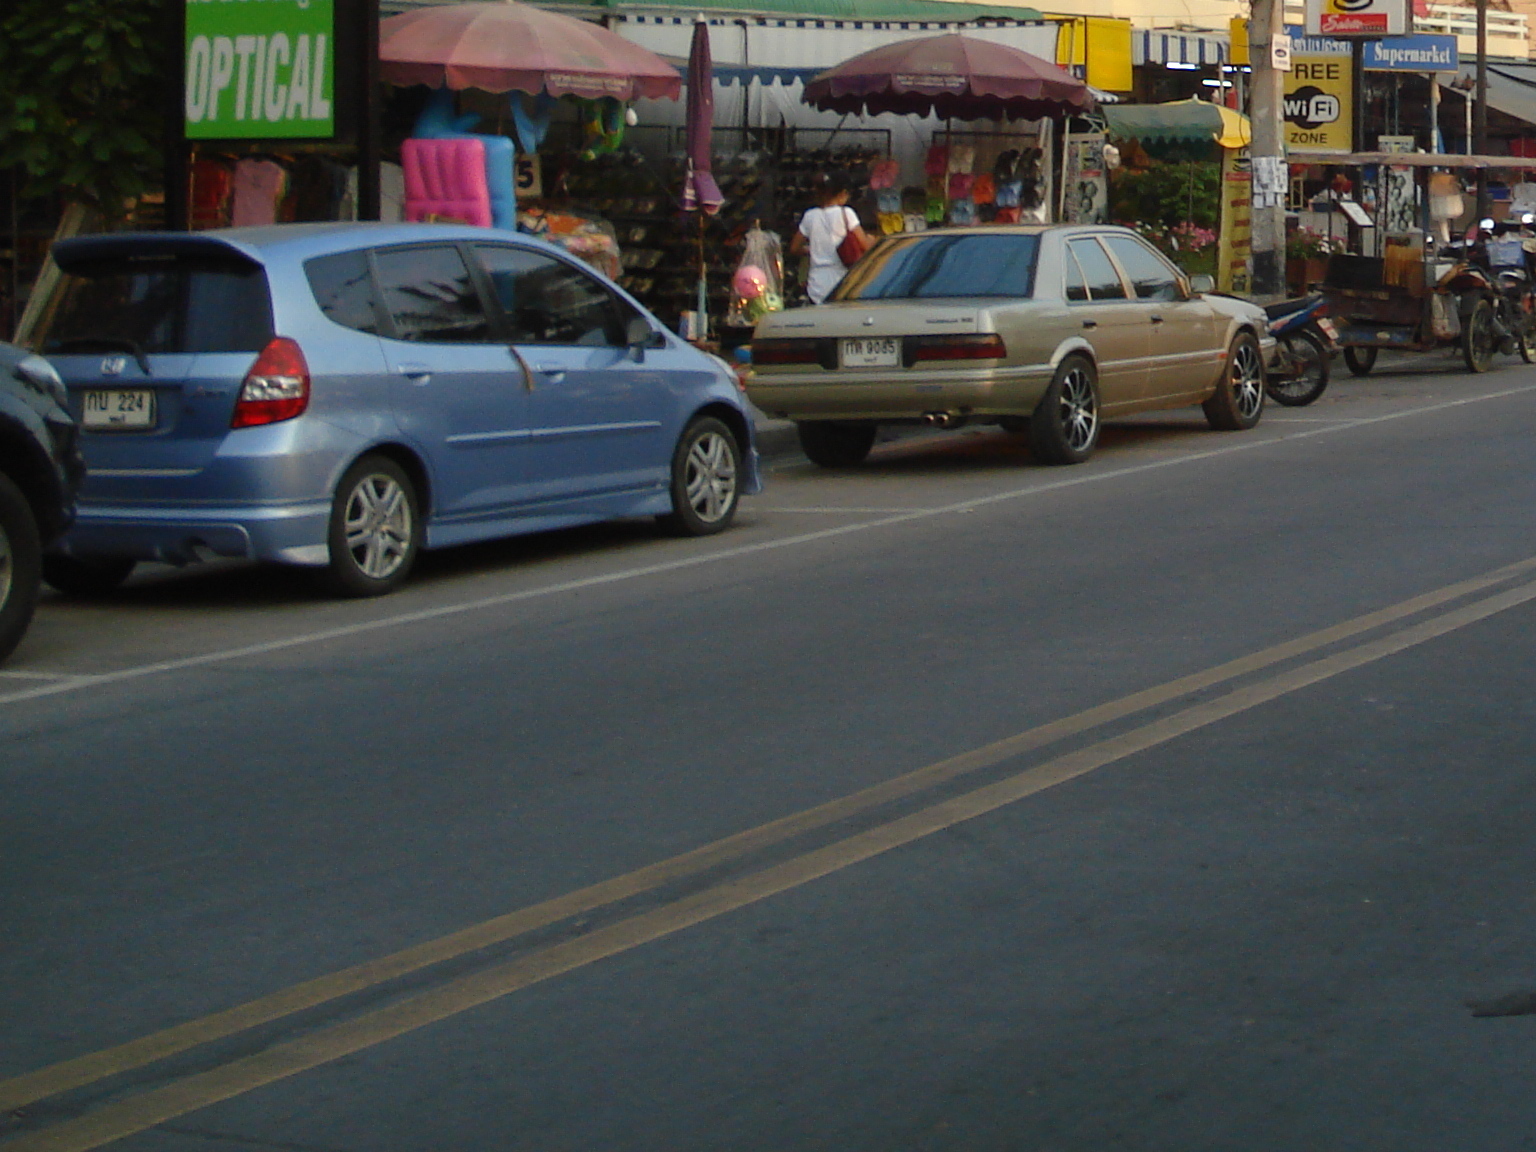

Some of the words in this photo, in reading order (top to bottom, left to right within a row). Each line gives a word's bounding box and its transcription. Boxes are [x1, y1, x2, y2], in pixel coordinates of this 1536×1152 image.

[1374, 41, 1451, 65] Supermarket
[185, 32, 330, 122] OPTICAL
[1291, 133, 1327, 143] ZONE
[118, 394, 143, 412] 224
